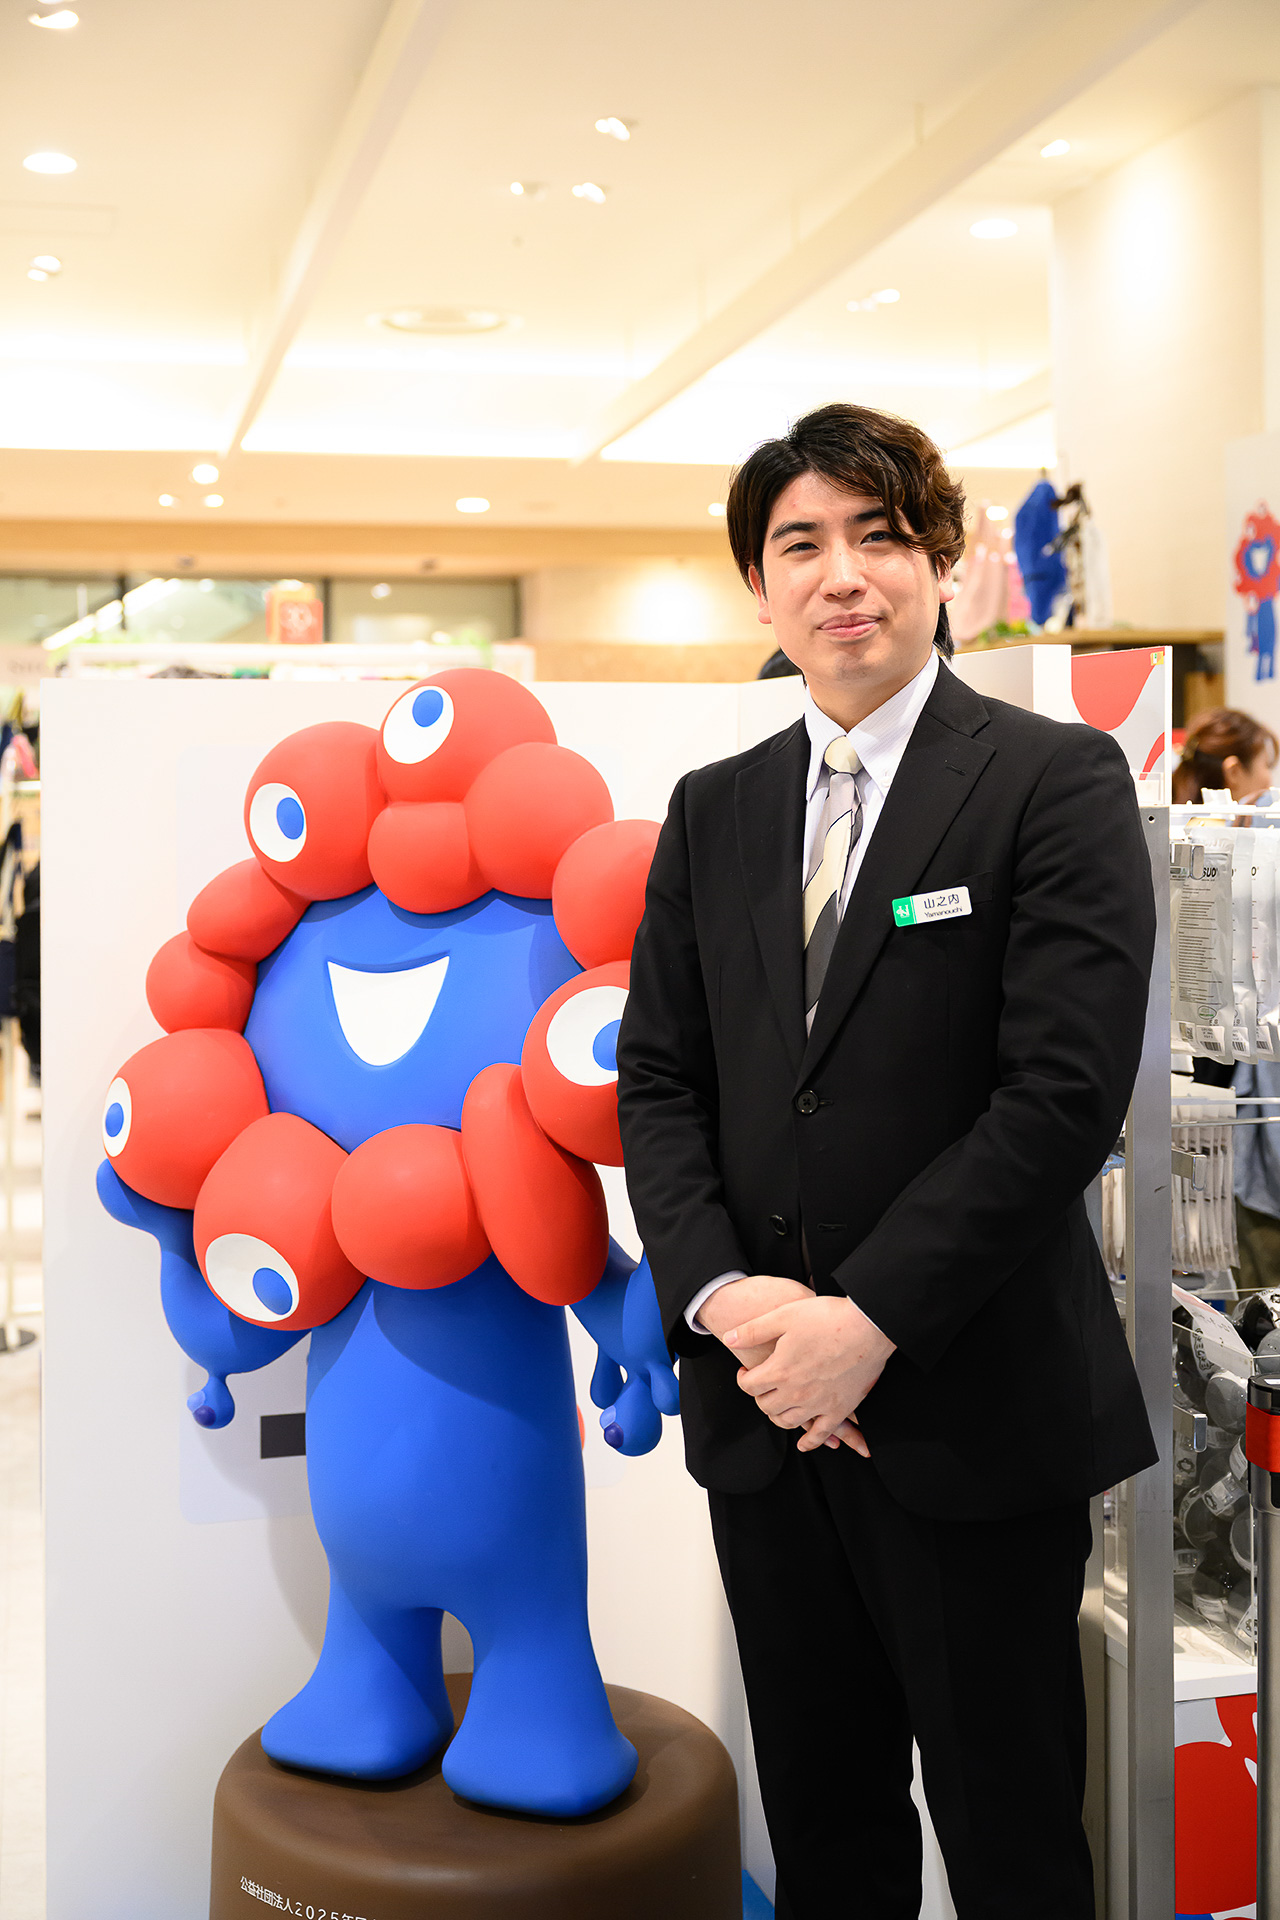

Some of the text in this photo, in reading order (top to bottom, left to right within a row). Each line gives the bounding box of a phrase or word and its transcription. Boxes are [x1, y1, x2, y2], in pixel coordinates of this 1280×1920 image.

[923, 893, 960, 909] 山之内
[924, 906, 963, 918] Yamanouchi
[240, 1875, 376, 1920] 公益社団法人2025
